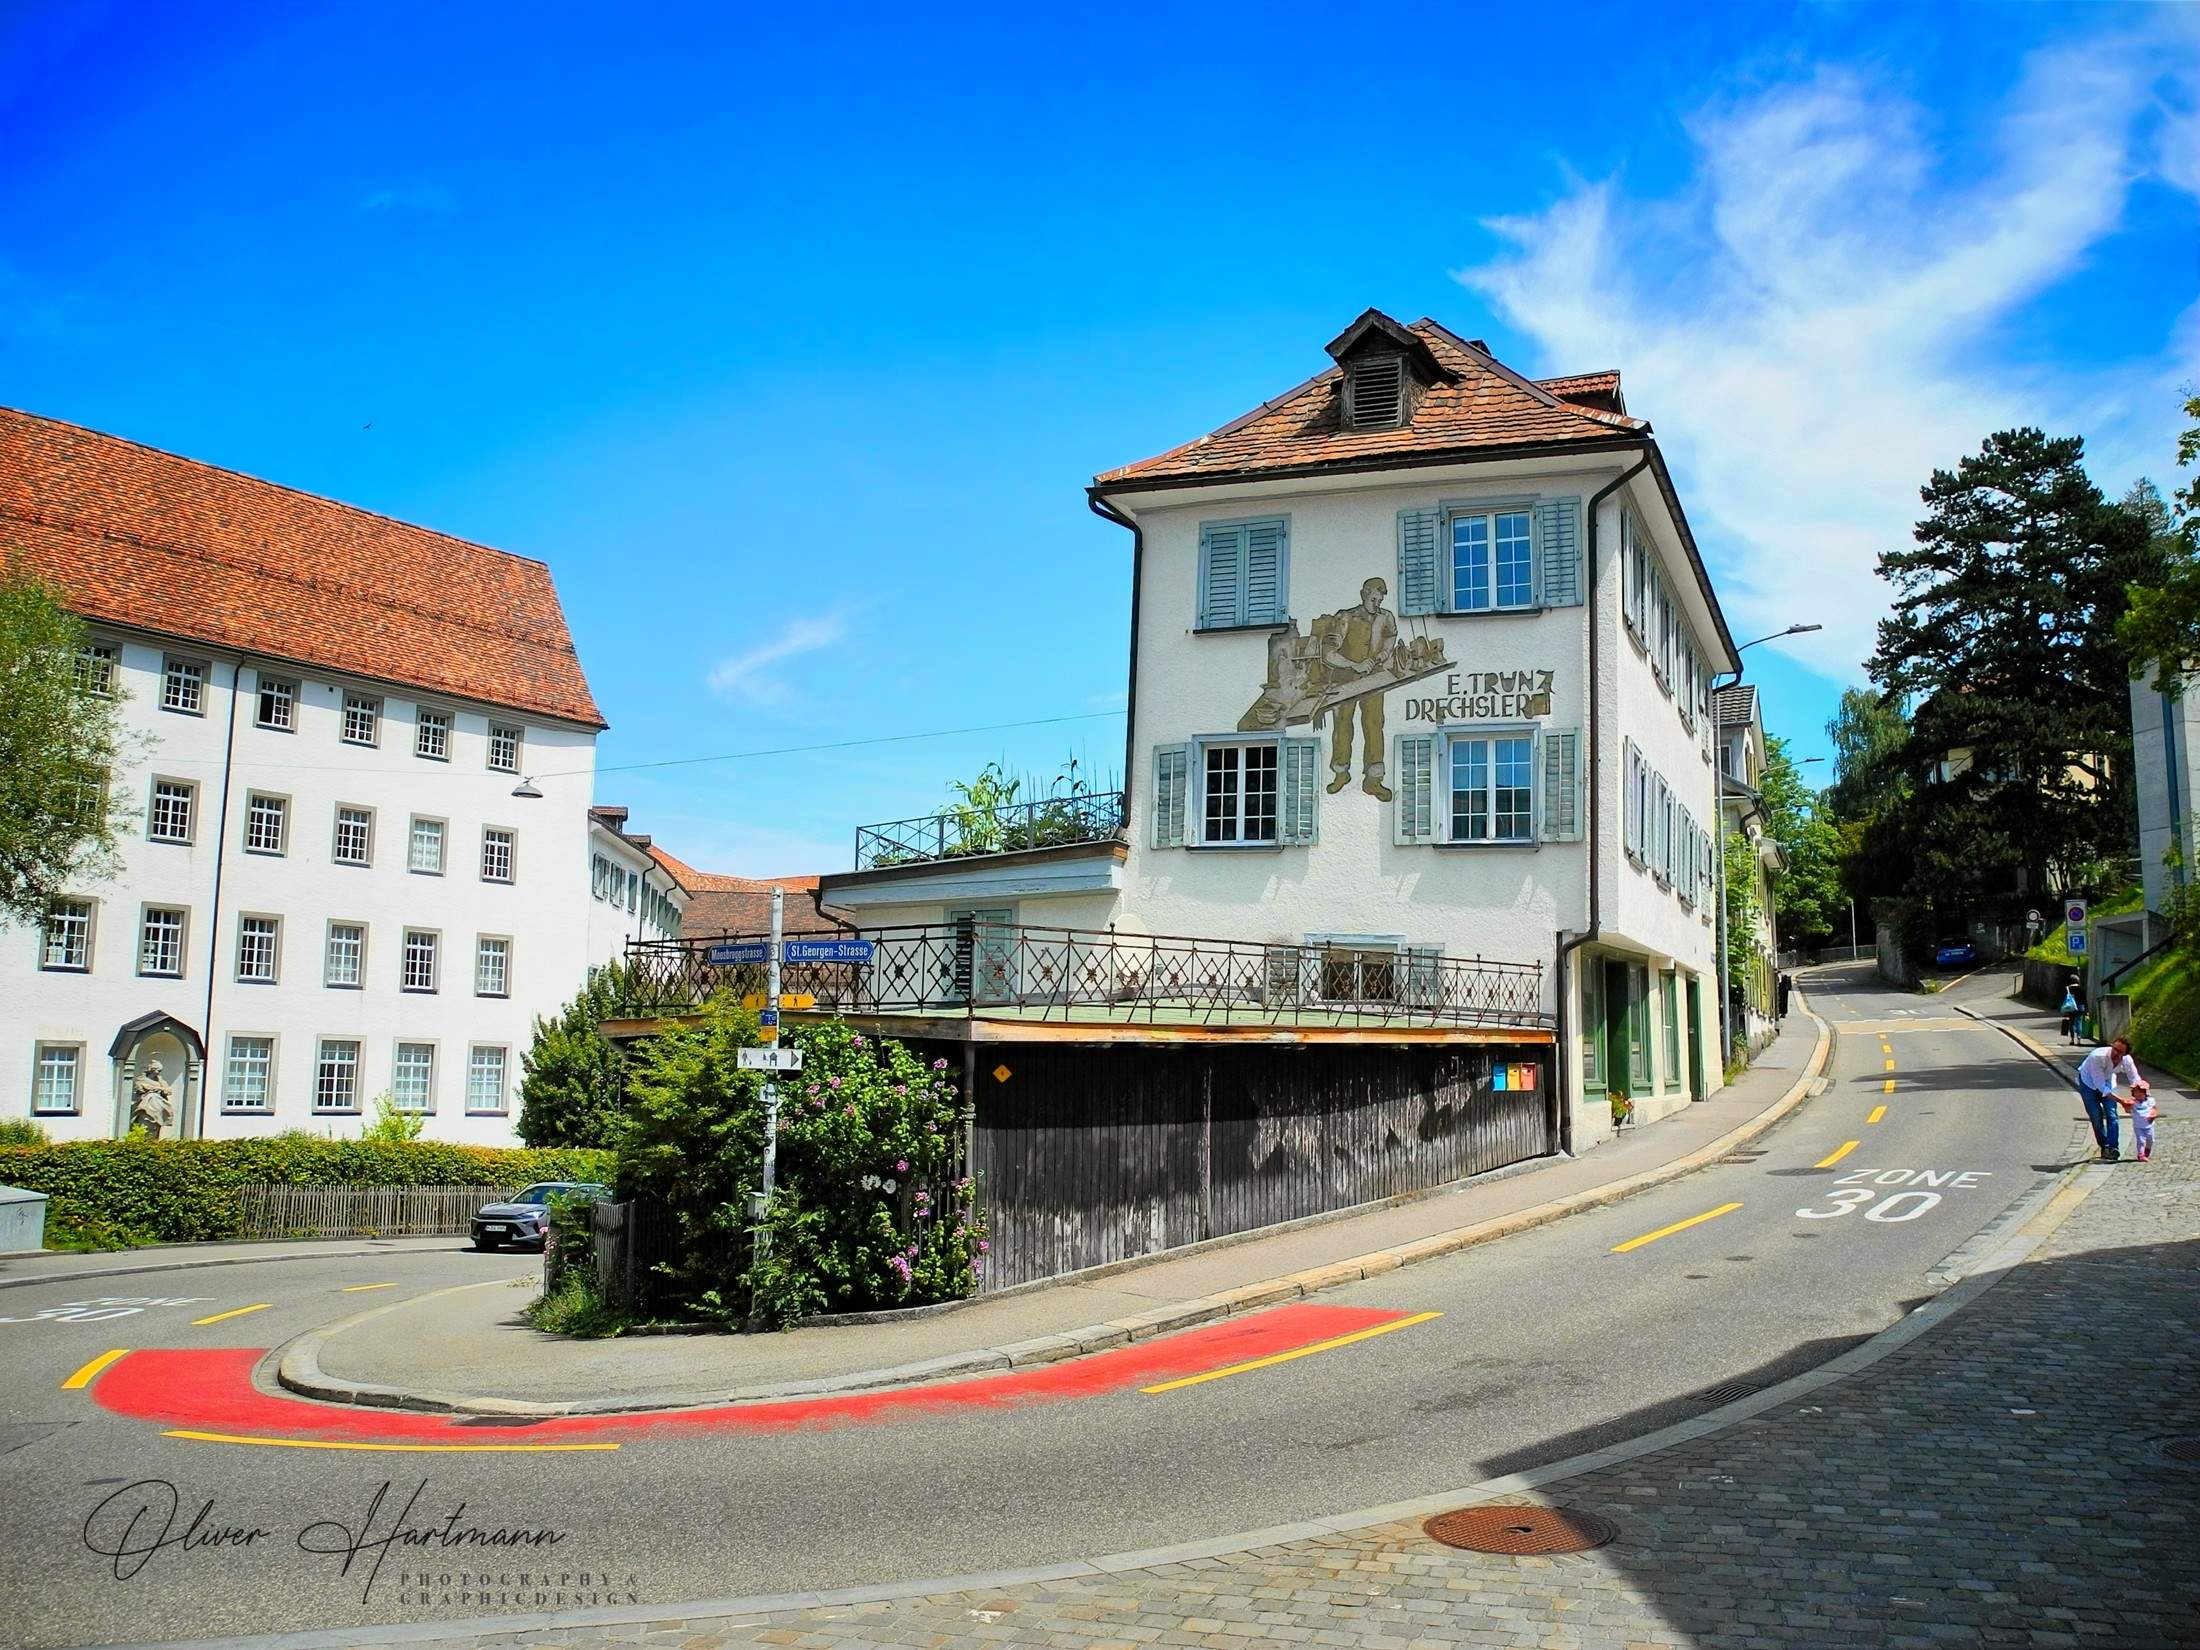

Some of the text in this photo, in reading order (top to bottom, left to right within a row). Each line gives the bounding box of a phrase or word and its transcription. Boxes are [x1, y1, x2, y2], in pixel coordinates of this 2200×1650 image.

[711, 948, 763, 962] Moosbruggstrasse
[1833, 1169, 1992, 1188] ZONE
[1795, 1188, 1942, 1222] 30
